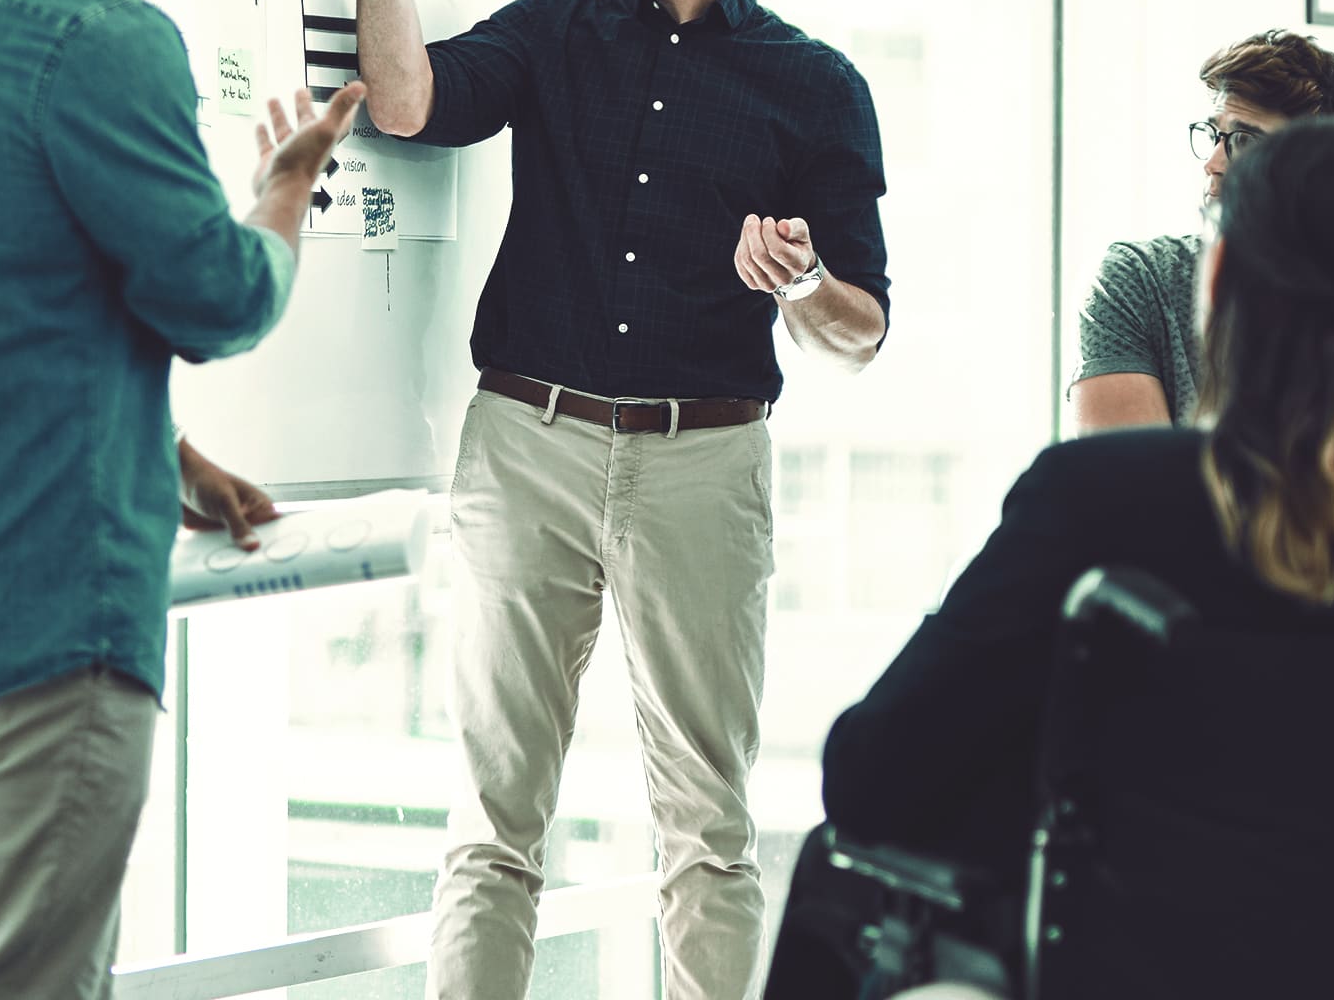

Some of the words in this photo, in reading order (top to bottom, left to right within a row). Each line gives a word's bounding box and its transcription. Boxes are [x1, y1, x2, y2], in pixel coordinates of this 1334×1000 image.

[352, 122, 383, 140] mission
[342, 157, 367, 173] vision
[336, 190, 356, 206] idea
